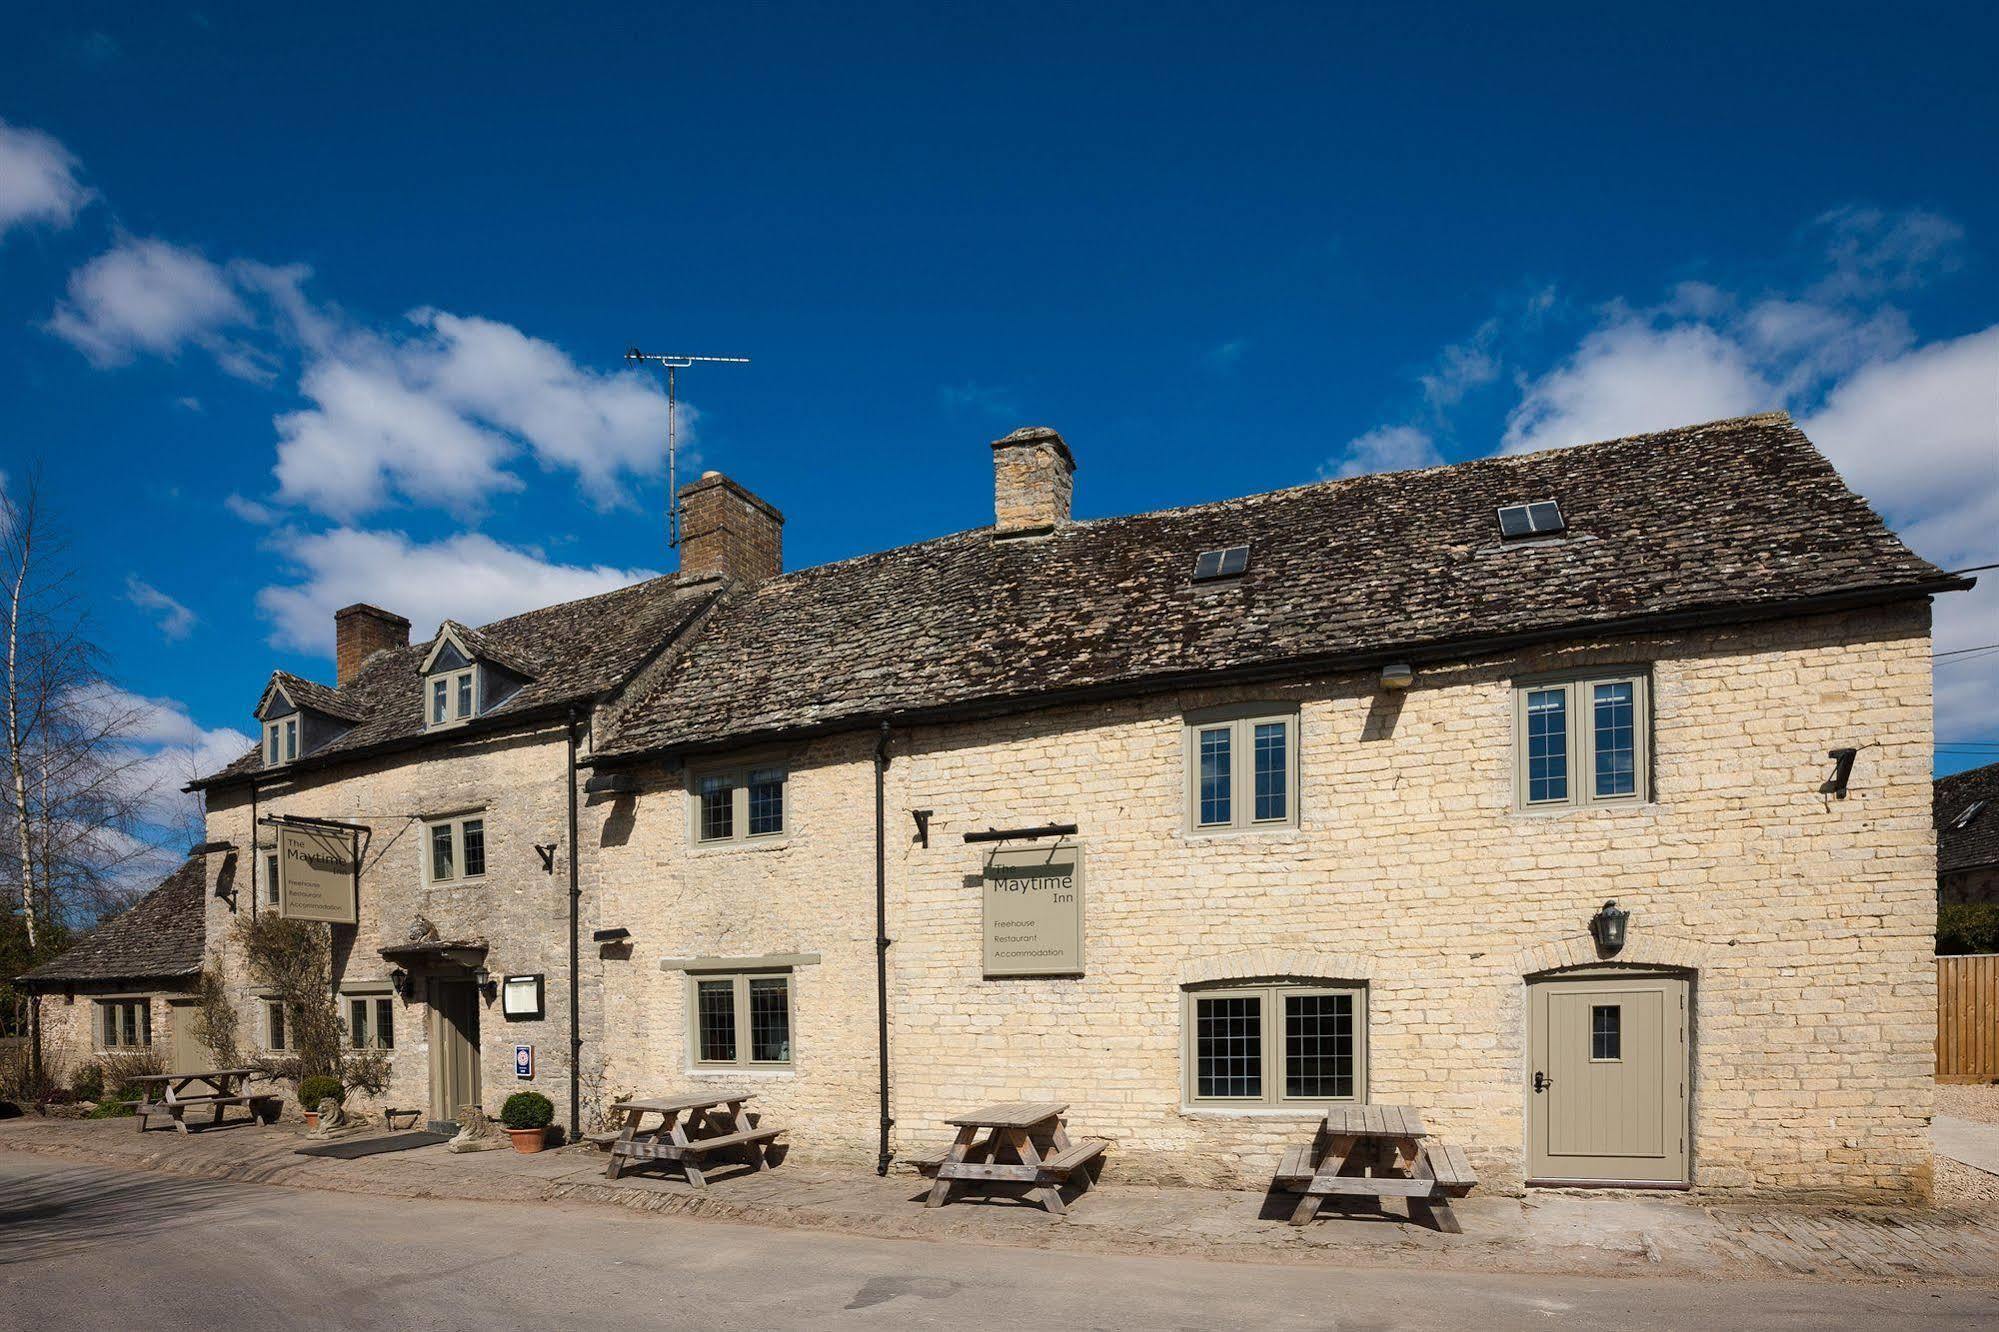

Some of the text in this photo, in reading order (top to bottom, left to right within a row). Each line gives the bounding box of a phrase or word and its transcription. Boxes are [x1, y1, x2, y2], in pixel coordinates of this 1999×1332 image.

[287, 839, 305, 848] The
[287, 849, 346, 866] Maytime
[333, 867, 347, 875] Inn
[994, 864, 1016, 874] The
[288, 880, 320, 888] Freehouse
[994, 876, 1072, 894] Maytime
[1053, 893, 1073, 903] Inn
[289, 902, 343, 911] Accommodation
[994, 920, 1035, 928] Freehouse
[994, 935, 1037, 943] Restaurant
[994, 949, 1064, 958] Accommodation
